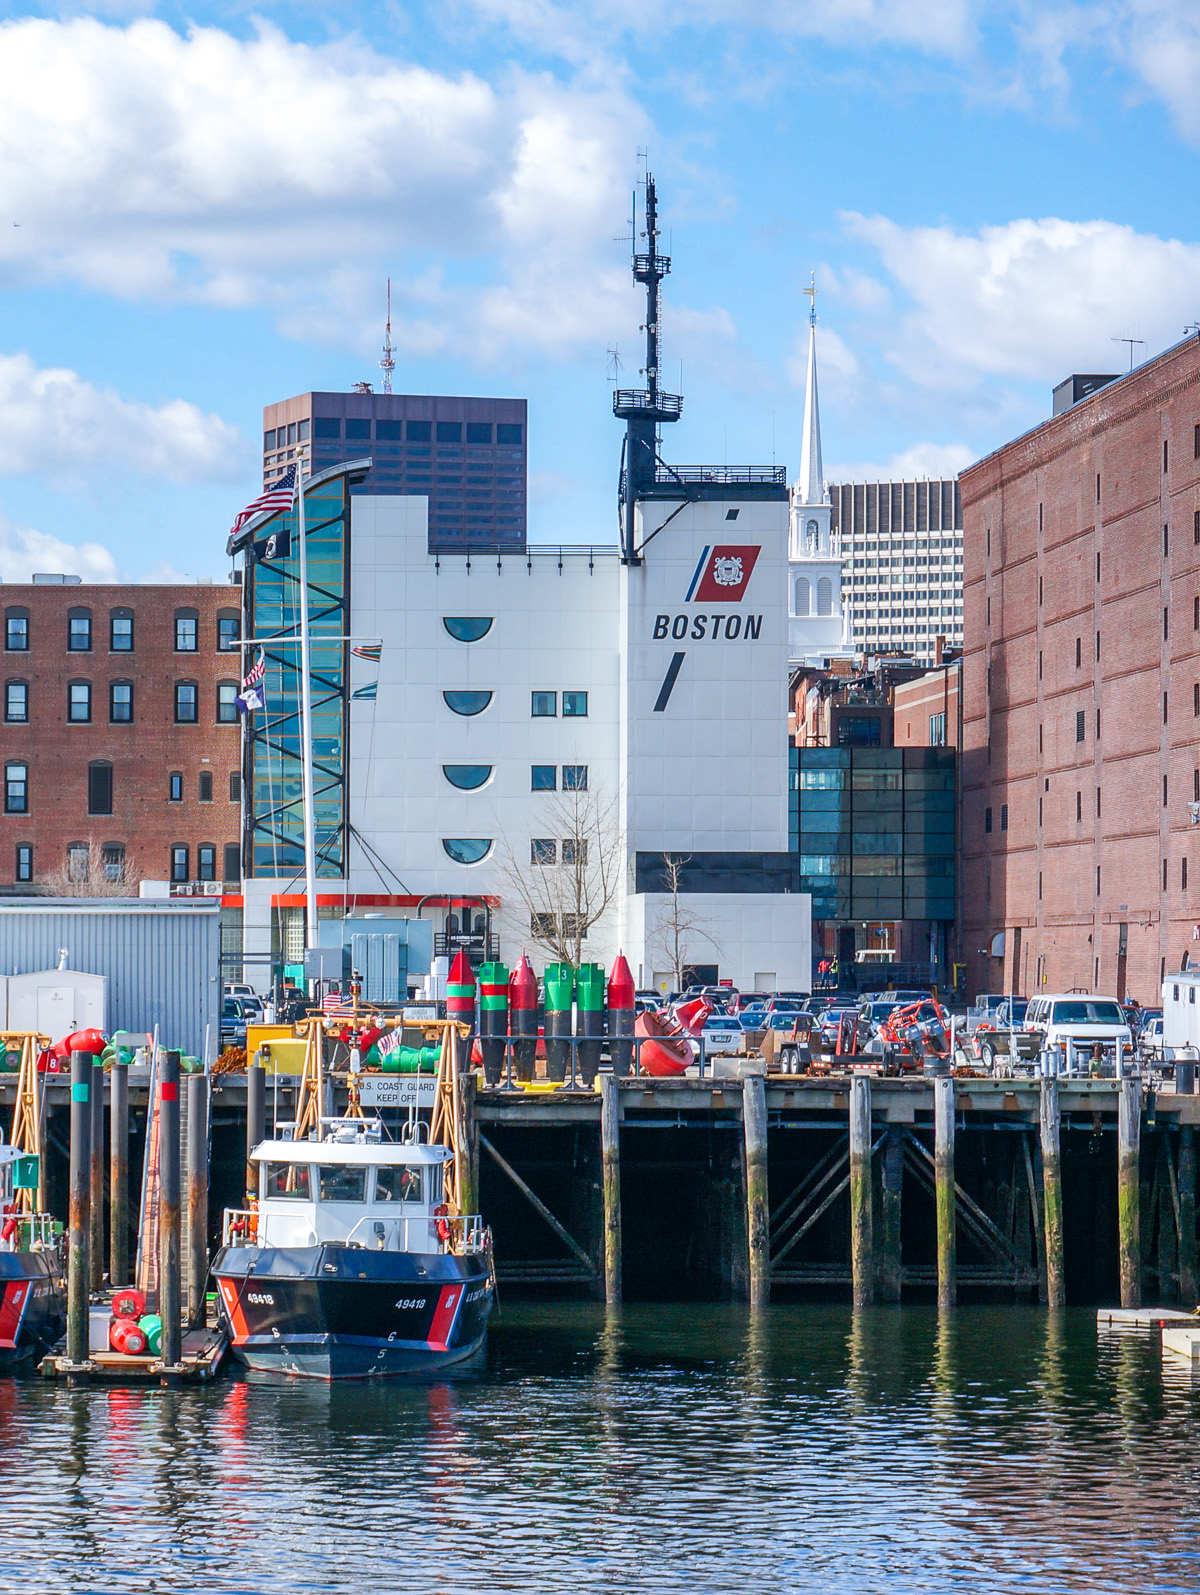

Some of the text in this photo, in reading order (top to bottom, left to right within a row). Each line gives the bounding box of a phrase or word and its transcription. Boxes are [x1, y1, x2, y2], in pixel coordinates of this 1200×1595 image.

[653, 615, 763, 640] BOSTON
[561, 969, 567, 980] 3
[49, 1058, 57, 1068] 8
[377, 1082, 404, 1091] COAST
[407, 1082, 435, 1091] GUARD
[376, 1094, 417, 1102] KEEP OFF
[27, 1163, 34, 1175] 7
[247, 1293, 274, 1305] 49418
[395, 1299, 426, 1310] 49418
[271, 1328, 280, 1339] 6
[387, 1331, 397, 1342] 6
[377, 1348, 387, 1359] 5
